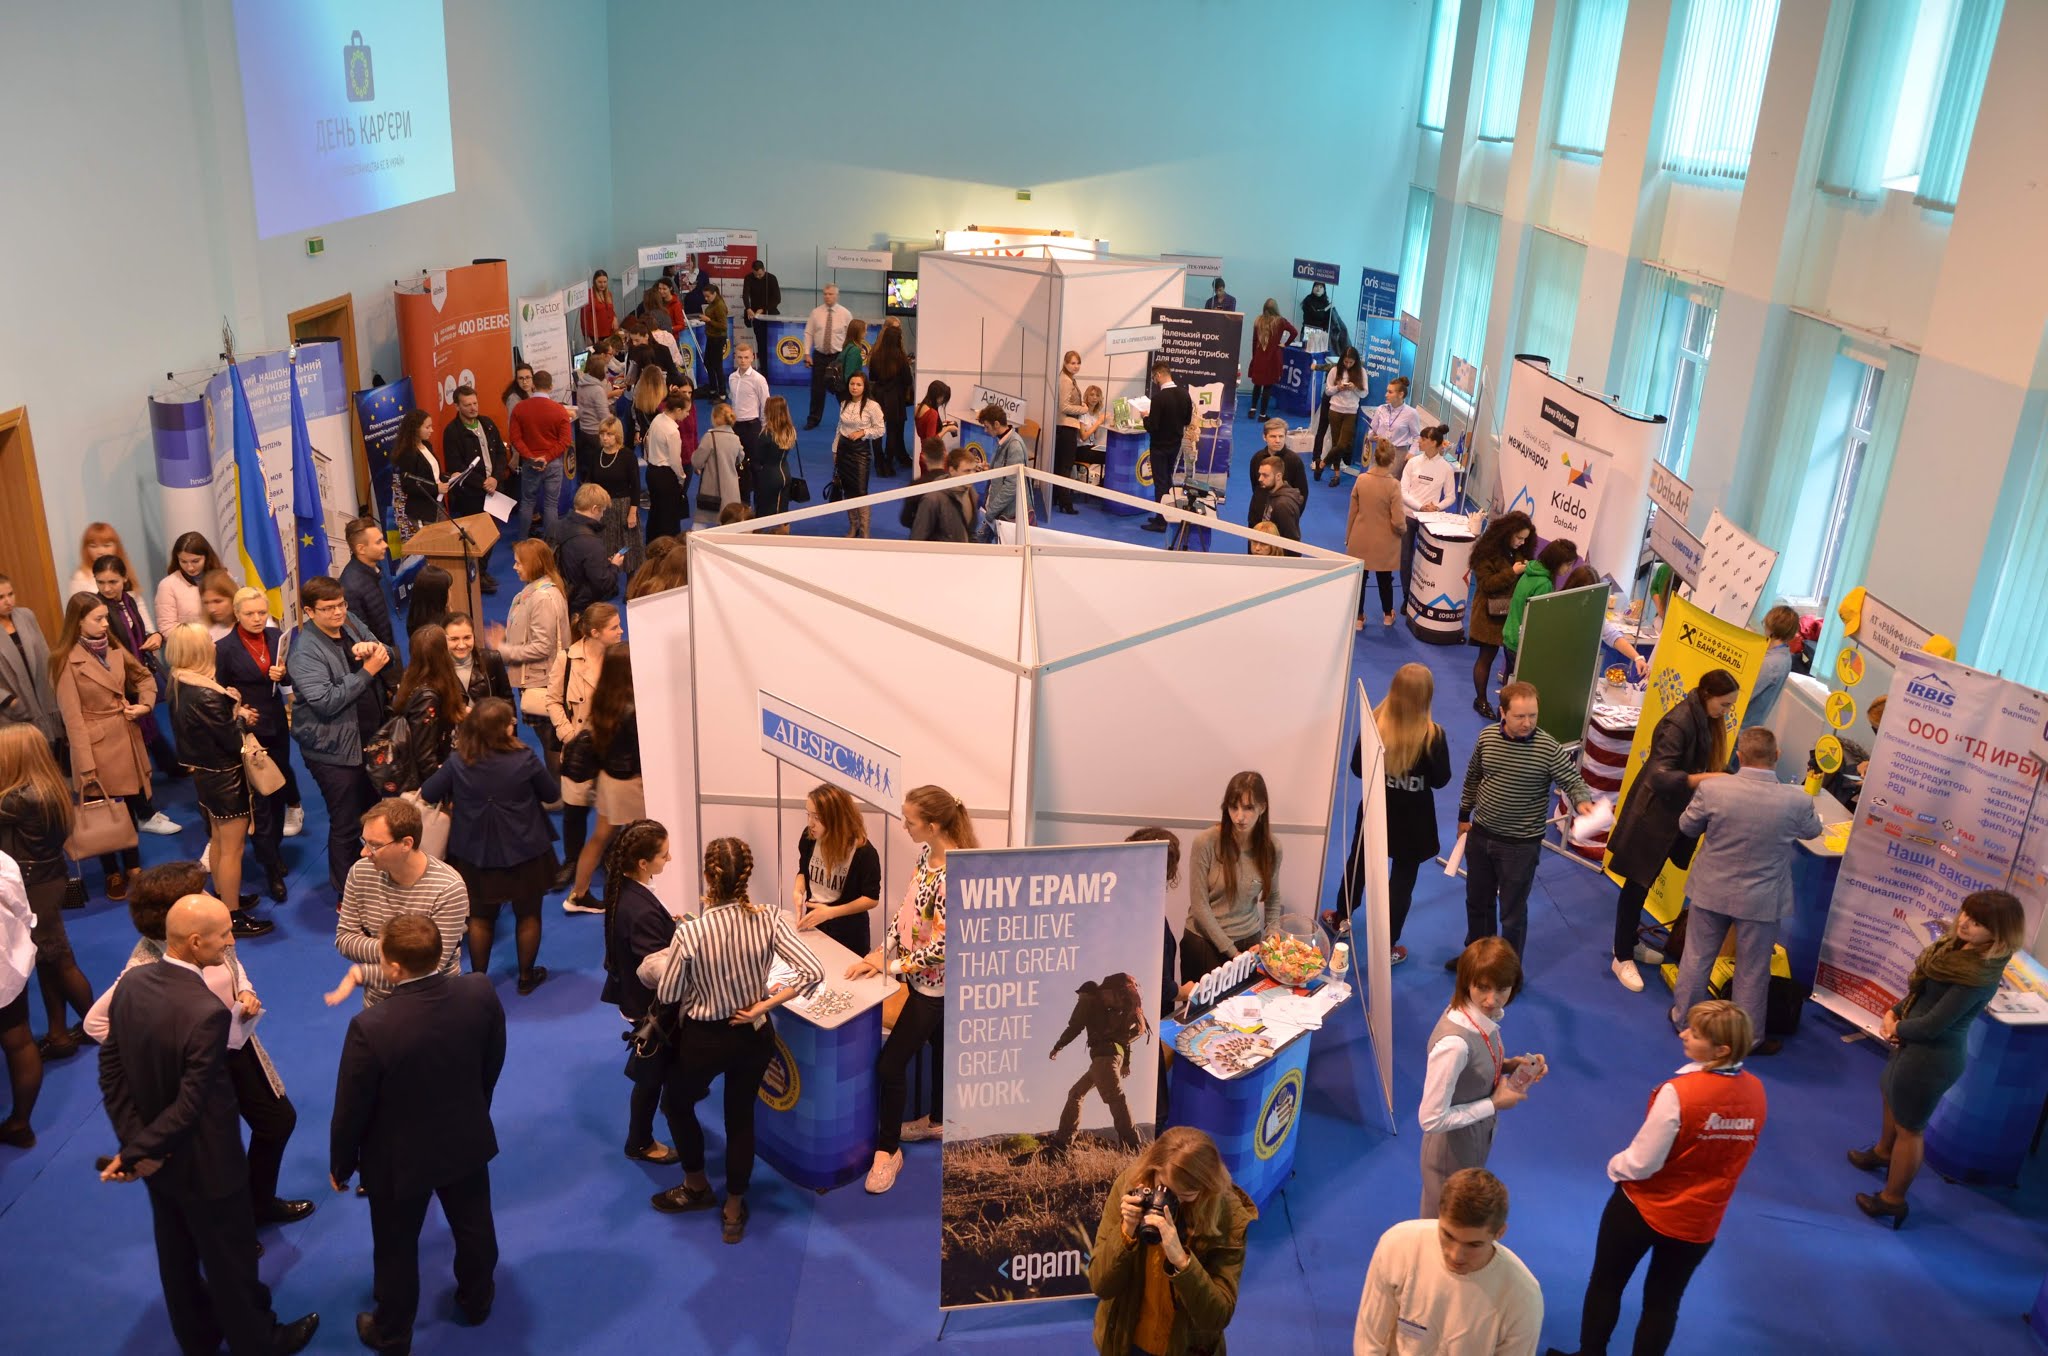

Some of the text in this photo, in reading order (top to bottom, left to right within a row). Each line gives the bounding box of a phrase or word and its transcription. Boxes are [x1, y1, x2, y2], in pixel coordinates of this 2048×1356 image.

[316, 110, 412, 156] ДЕНЬ КАР'ЄРИ
[646, 249, 679, 261] mobidev
[1297, 263, 1315, 276] aris
[1364, 275, 1379, 289] aris
[535, 302, 560, 315] Factor
[458, 319, 475, 336] 400
[476, 313, 510, 333] BEERS
[1172, 338, 1202, 348] людини
[1201, 332, 1220, 341] крок
[1370, 335, 1391, 347] The only
[1166, 347, 1197, 356] великий
[1198, 350, 1230, 359] стрибок
[1368, 353, 1386, 363] journey
[1369, 344, 1395, 355] impossible
[1155, 354, 1200, 365] для кар'єри
[1376, 363, 1387, 371] you
[258, 358, 322, 384] НАЦІОНЬНИЙ
[270, 472, 283, 481] МОВ
[1551, 490, 1587, 520] Kiddo
[1656, 475, 1690, 516] DataArt
[1553, 515, 1579, 533] DataArt
[1872, 631, 1890, 649] БАНК
[1879, 621, 1921, 649] «РАЙФФАЙЗЕ
[1696, 640, 1741, 669] БАНК АВАЛЬ
[1906, 681, 1956, 707] IRBIS
[1903, 697, 1952, 719] www.irbis.ua
[774, 719, 848, 771] AIESEC
[1908, 718, 1949, 745] ООО
[1990, 746, 2048, 783] ИРБИ
[1386, 774, 1425, 792] ENDI
[1926, 785, 1952, 798] цепи
[1987, 786, 2032, 806] -сальник
[1981, 806, 2040, 834] -инструмнт
[1887, 840, 1936, 869] Наши
[960, 871, 1117, 910] WHY EPAM?
[1926, 891, 1938, 904] по
[1946, 888, 1959, 901] по
[1916, 900, 1927, 913] по
[960, 913, 1076, 944] WE BELIEVE
[958, 946, 1080, 978] THAT GREAT
[959, 980, 1040, 1011] PEOPLE
[958, 1015, 1033, 1044] CREATE
[958, 1048, 1022, 1077] GREAT
[957, 1079, 1030, 1111] WORK.
[1704, 1112, 1756, 1131] Ашан
